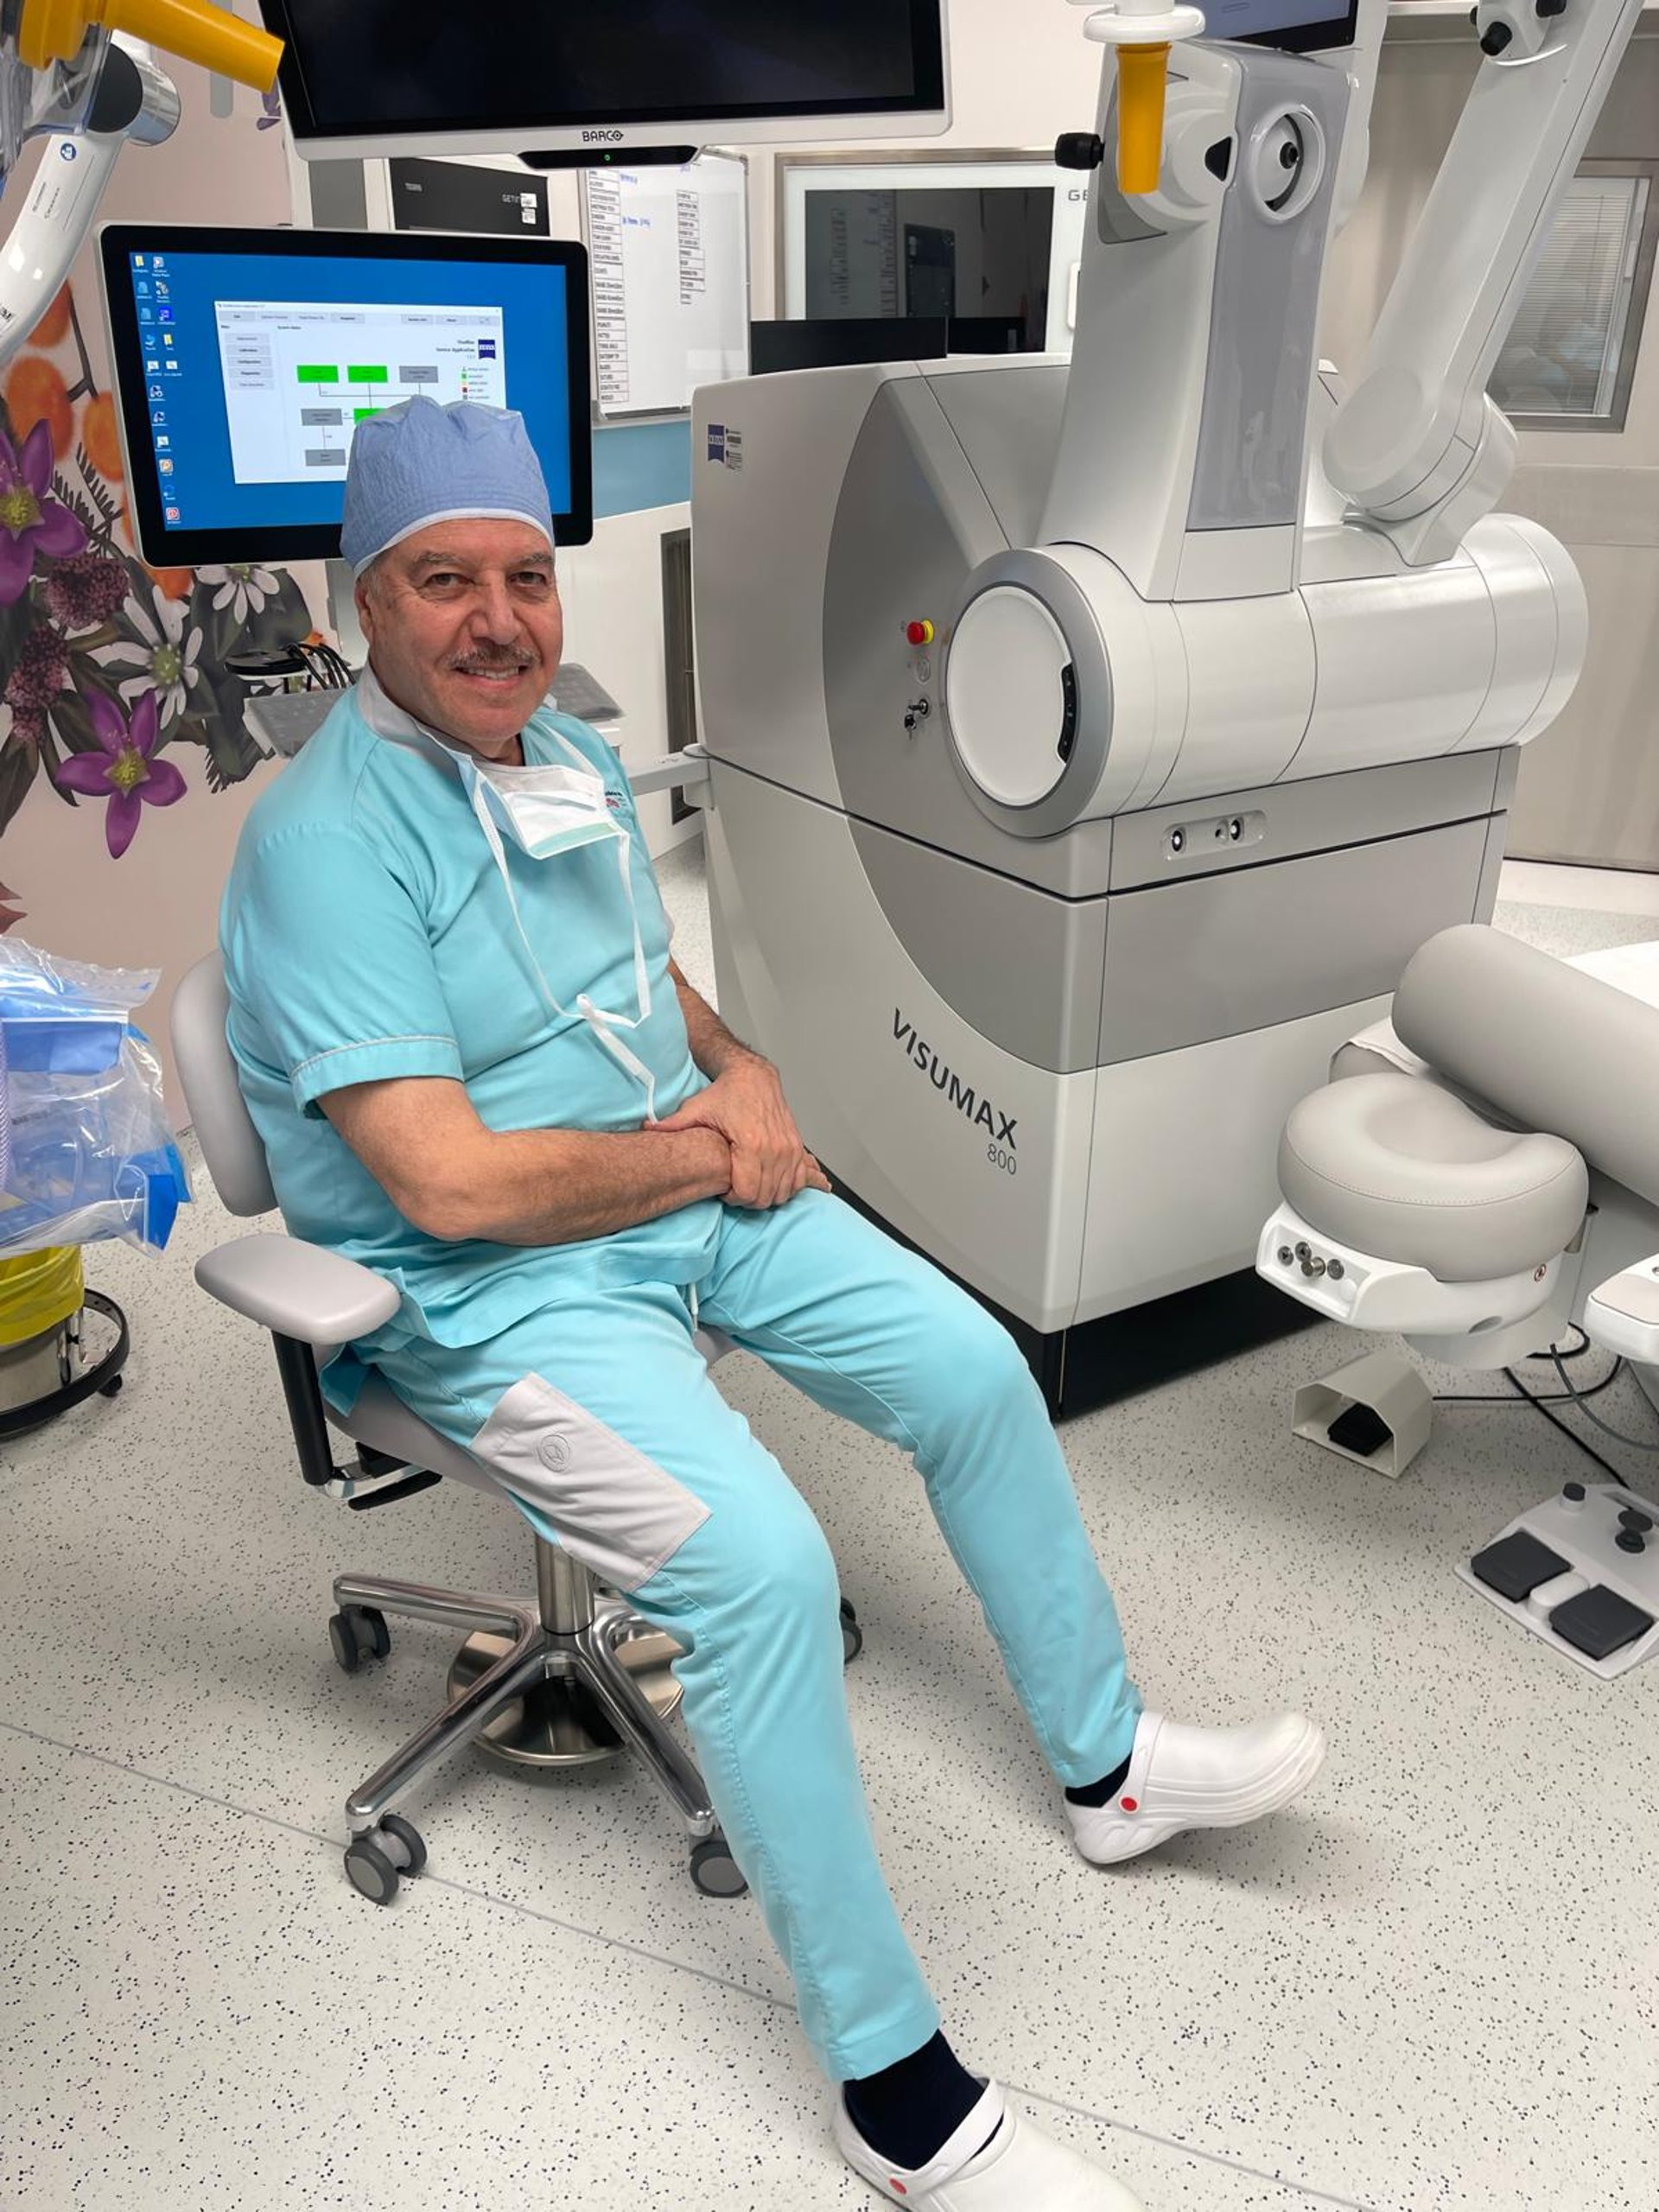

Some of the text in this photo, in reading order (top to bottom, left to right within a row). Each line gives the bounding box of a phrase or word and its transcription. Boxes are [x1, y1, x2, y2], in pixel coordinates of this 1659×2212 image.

[582, 130, 624, 142] BARCO
[893, 1007, 1018, 1150] VISUMAX
[987, 1142, 1017, 1175] 800
